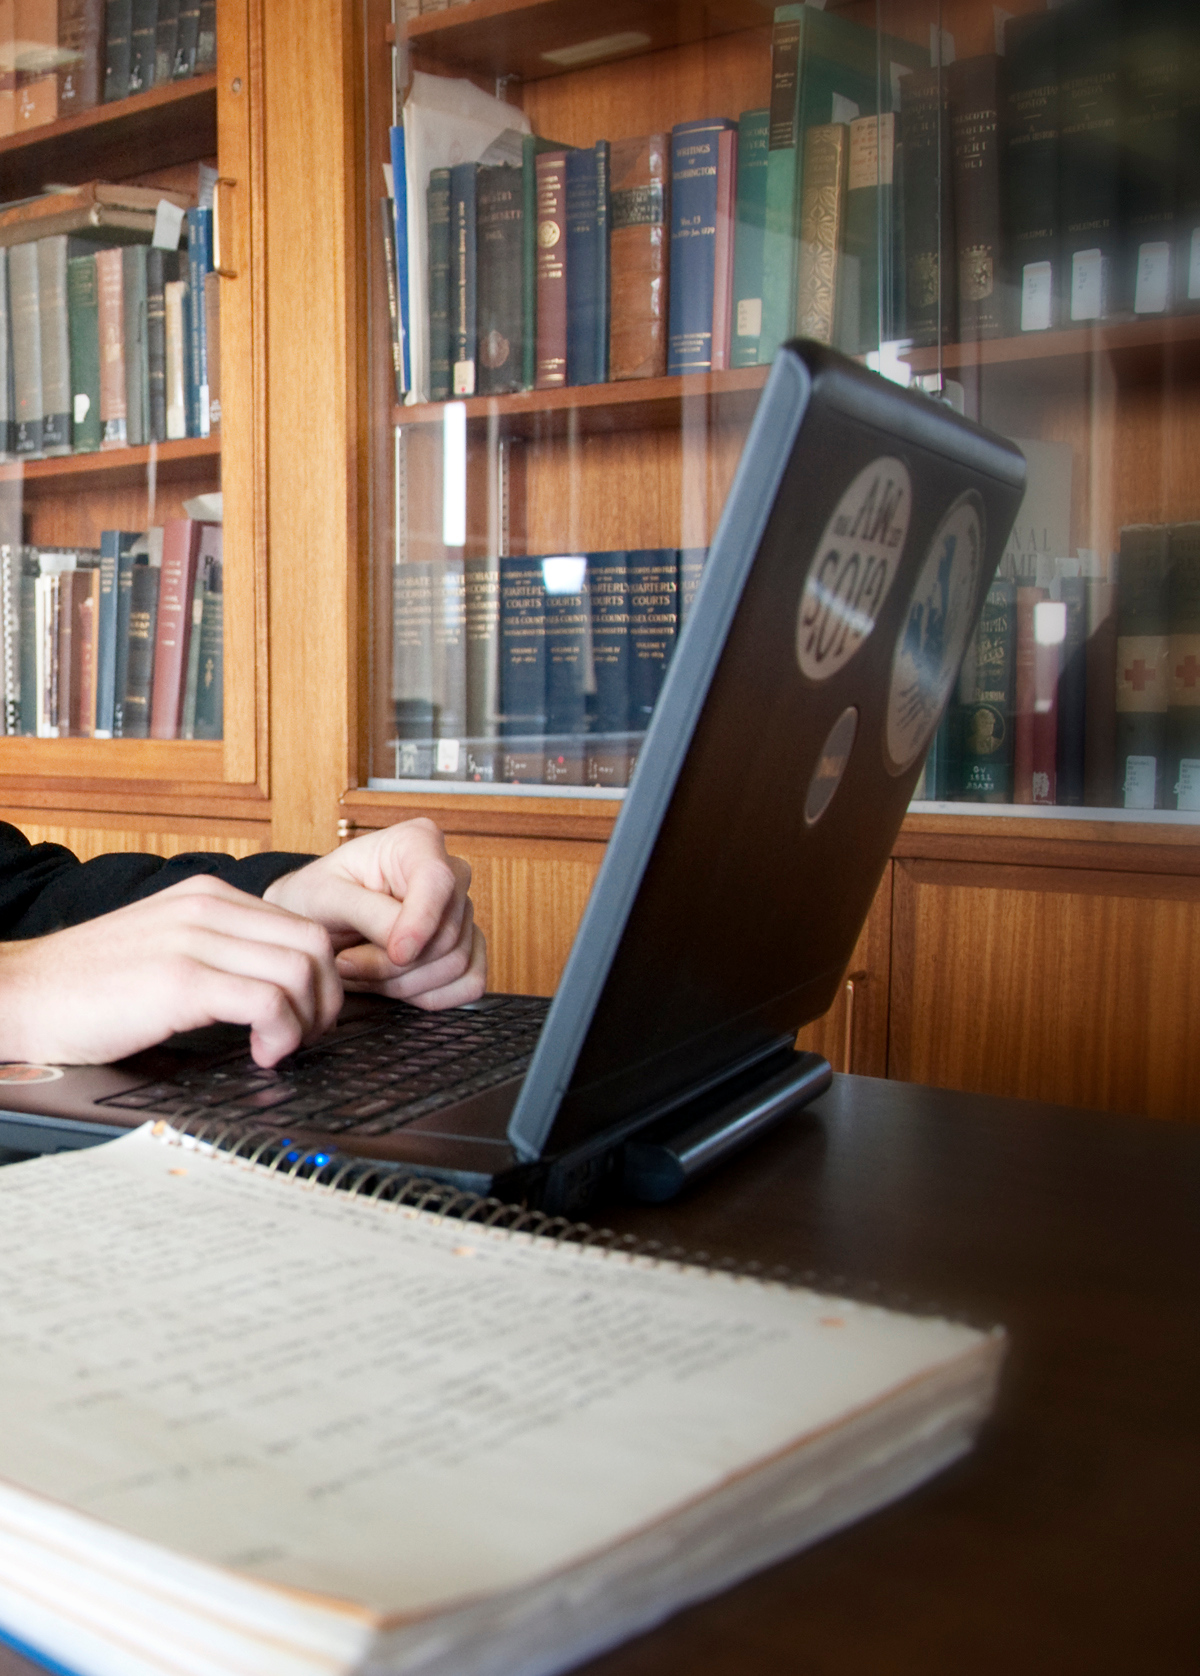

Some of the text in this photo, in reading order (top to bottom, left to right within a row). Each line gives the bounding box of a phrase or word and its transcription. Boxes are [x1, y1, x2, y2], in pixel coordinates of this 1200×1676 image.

[676, 143, 711, 158] WRITINGS
[505, 597, 542, 609] COURTS
[631, 594, 671, 606] COURTS
